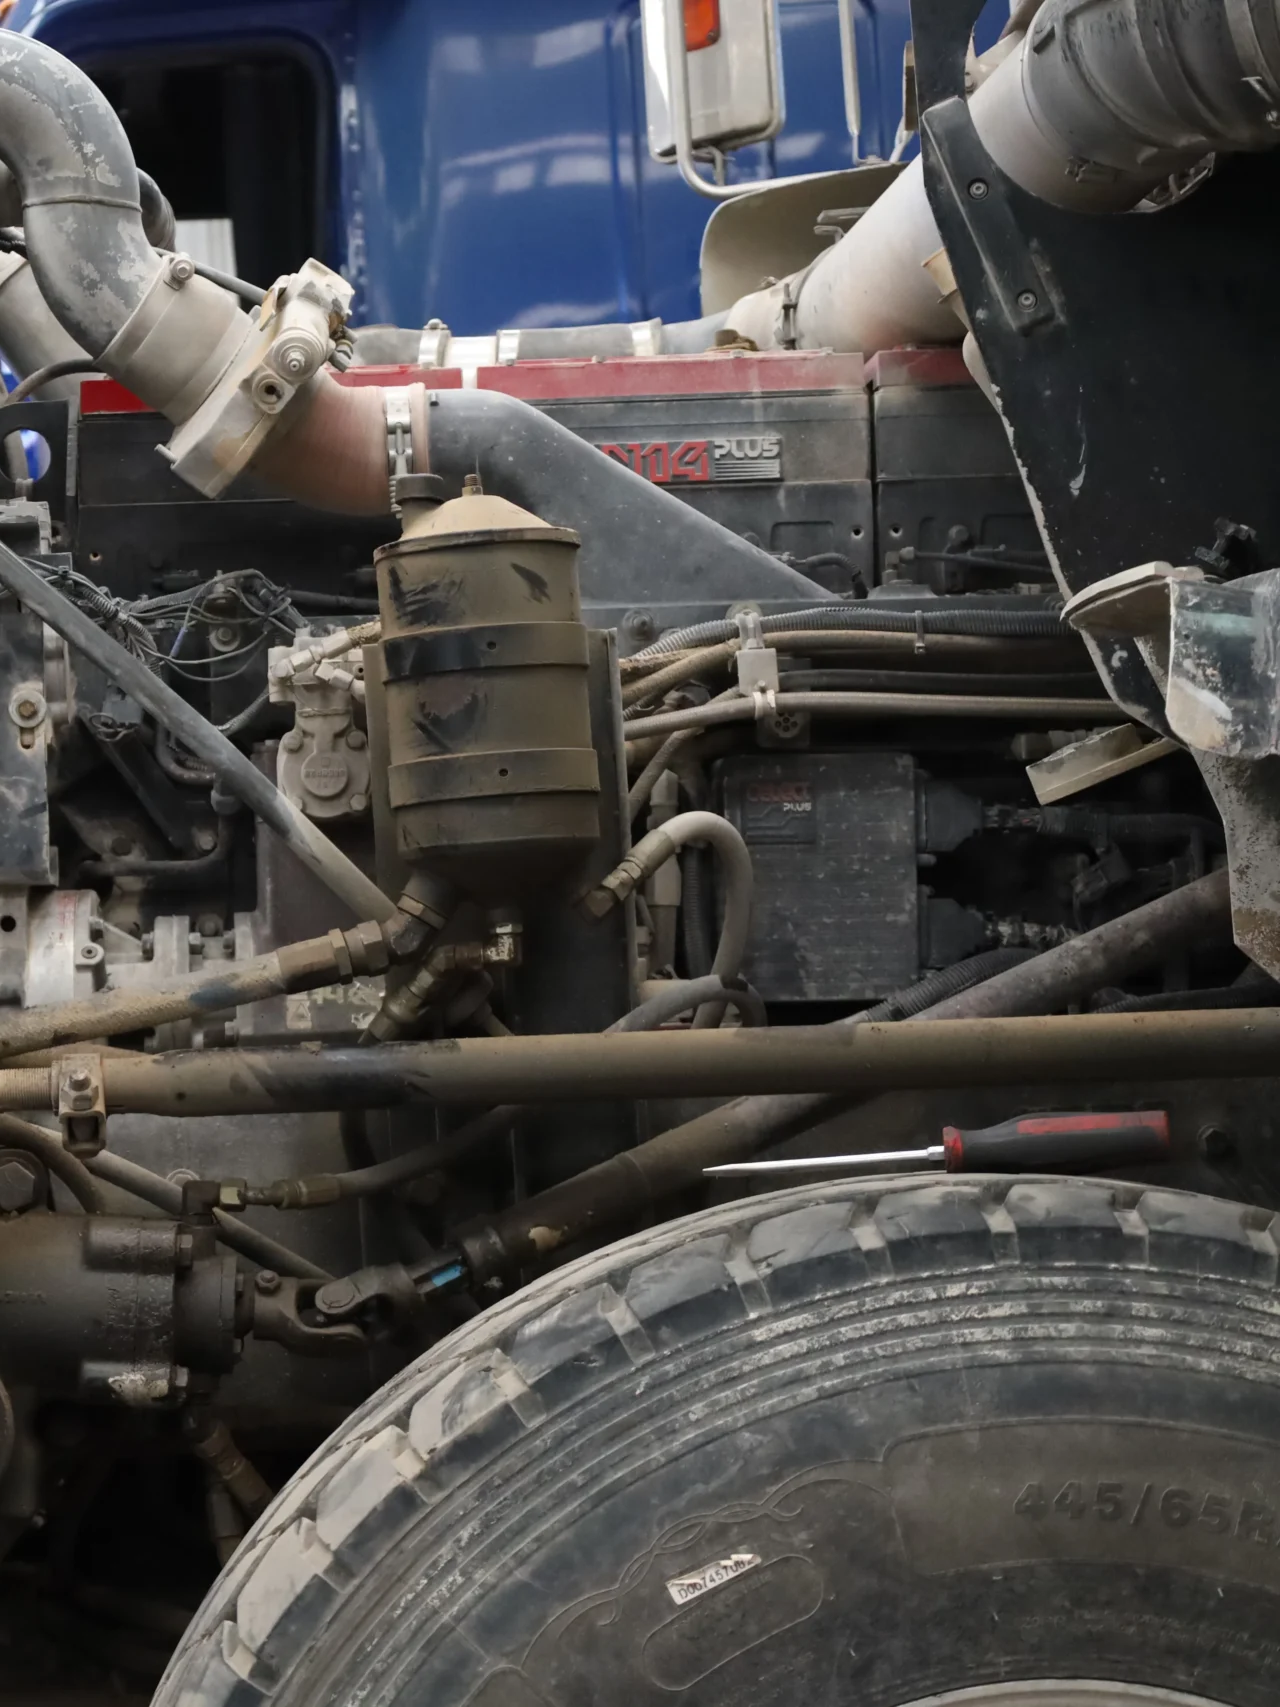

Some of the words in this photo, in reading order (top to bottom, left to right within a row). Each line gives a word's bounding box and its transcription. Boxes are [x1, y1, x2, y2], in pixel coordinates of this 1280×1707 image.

[714, 438, 780, 460] PLUS
[783, 802, 812, 811] PLUS
[1013, 1480, 1280, 1546] 445/65R
